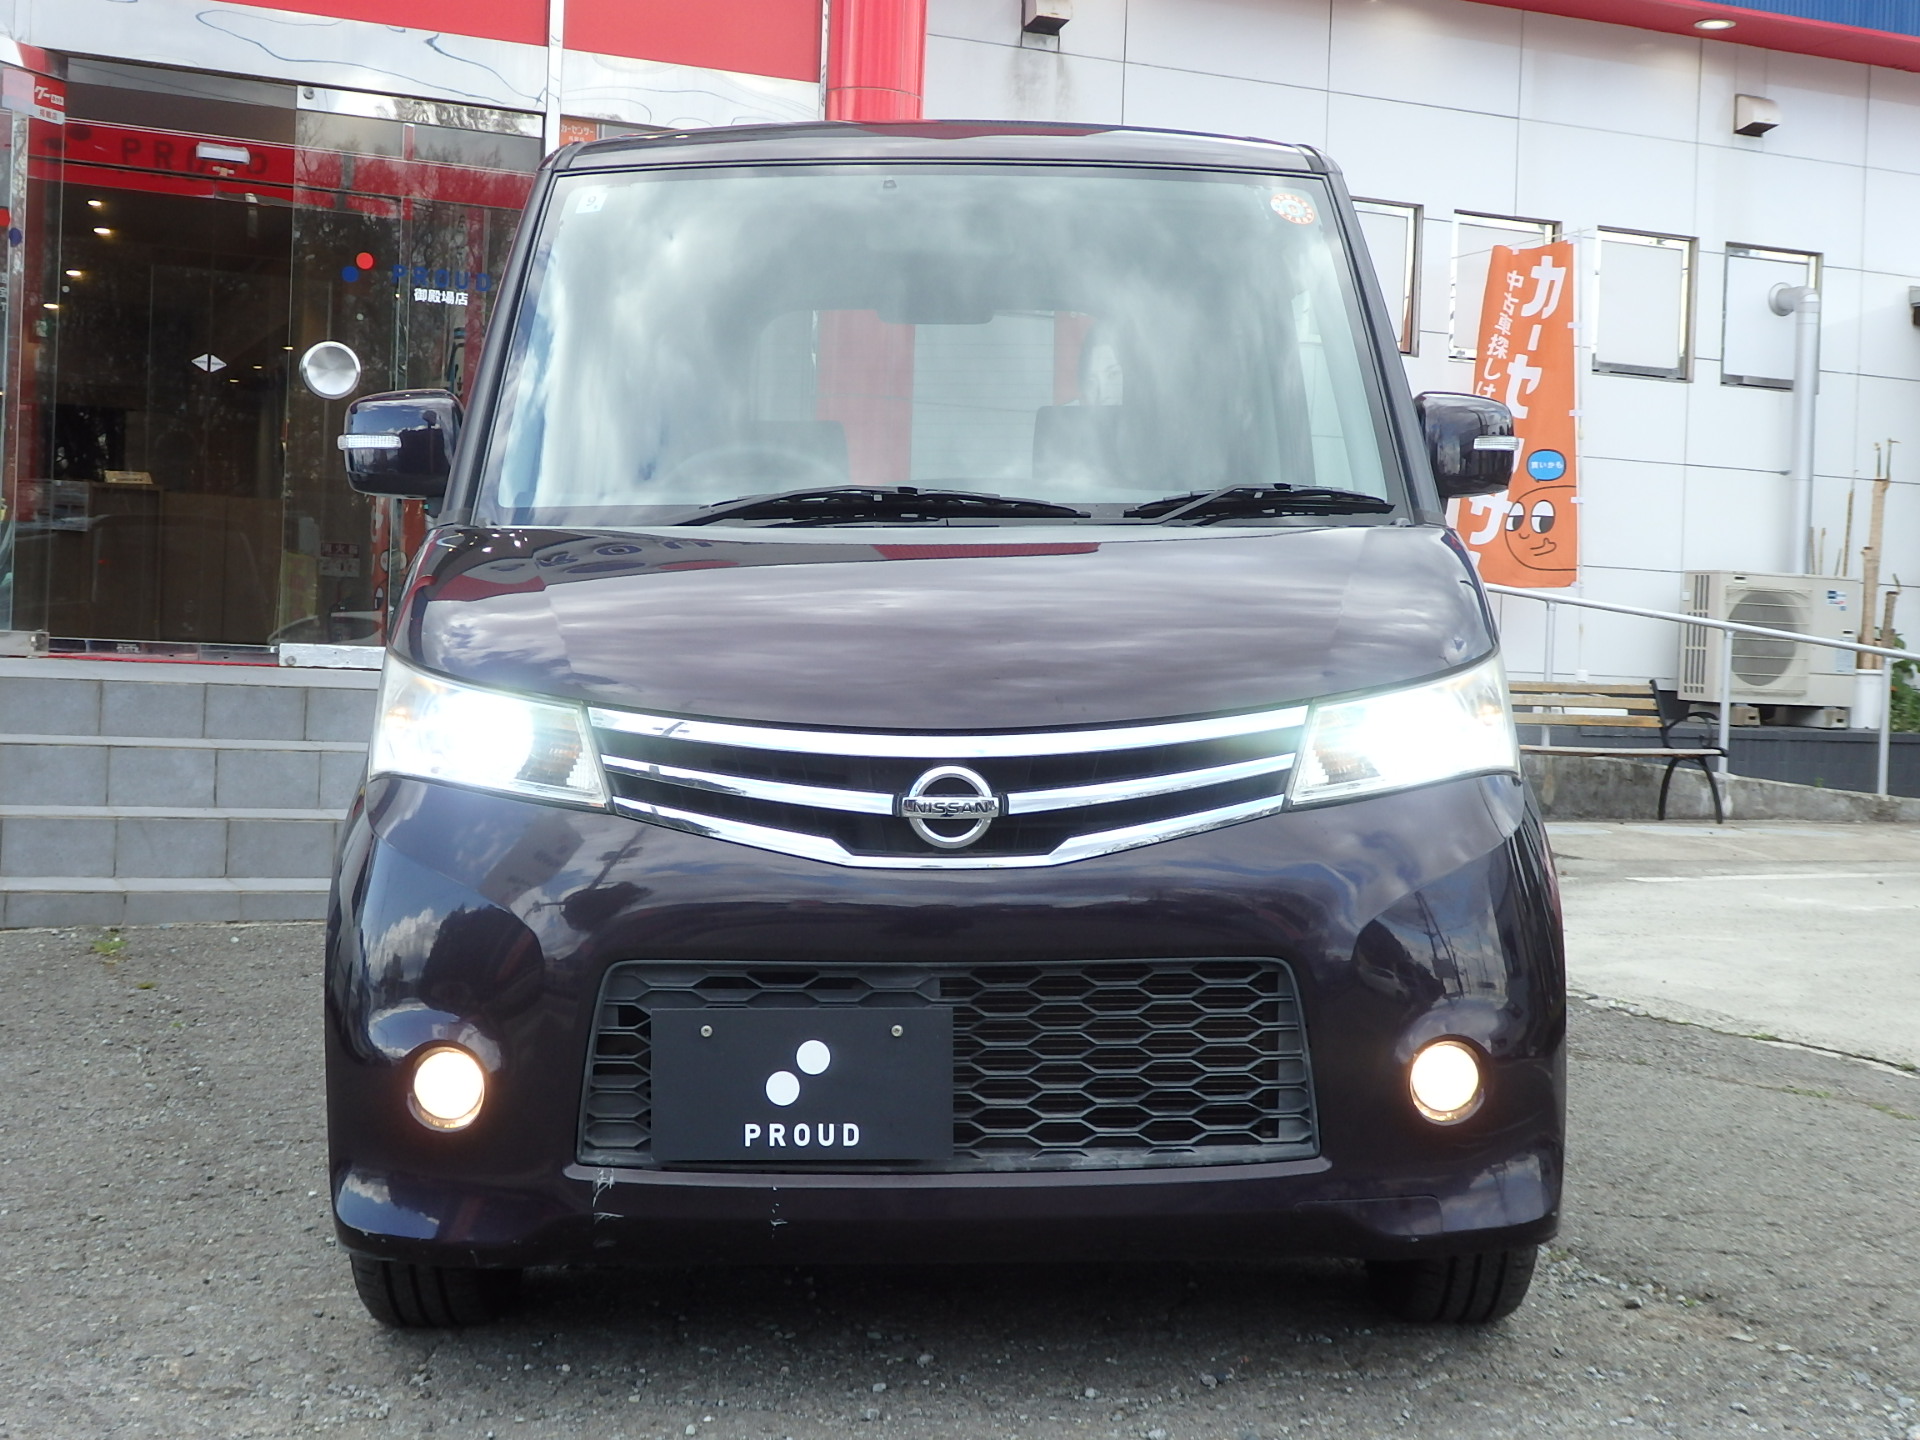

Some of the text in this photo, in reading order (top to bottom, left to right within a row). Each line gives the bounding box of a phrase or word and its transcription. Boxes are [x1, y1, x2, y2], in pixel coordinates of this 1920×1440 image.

[391, 263, 492, 293] PROUD
[413, 287, 469, 306] 御殿場店
[912, 802, 989, 814] NISSAN
[744, 1123, 860, 1147] PROUD
